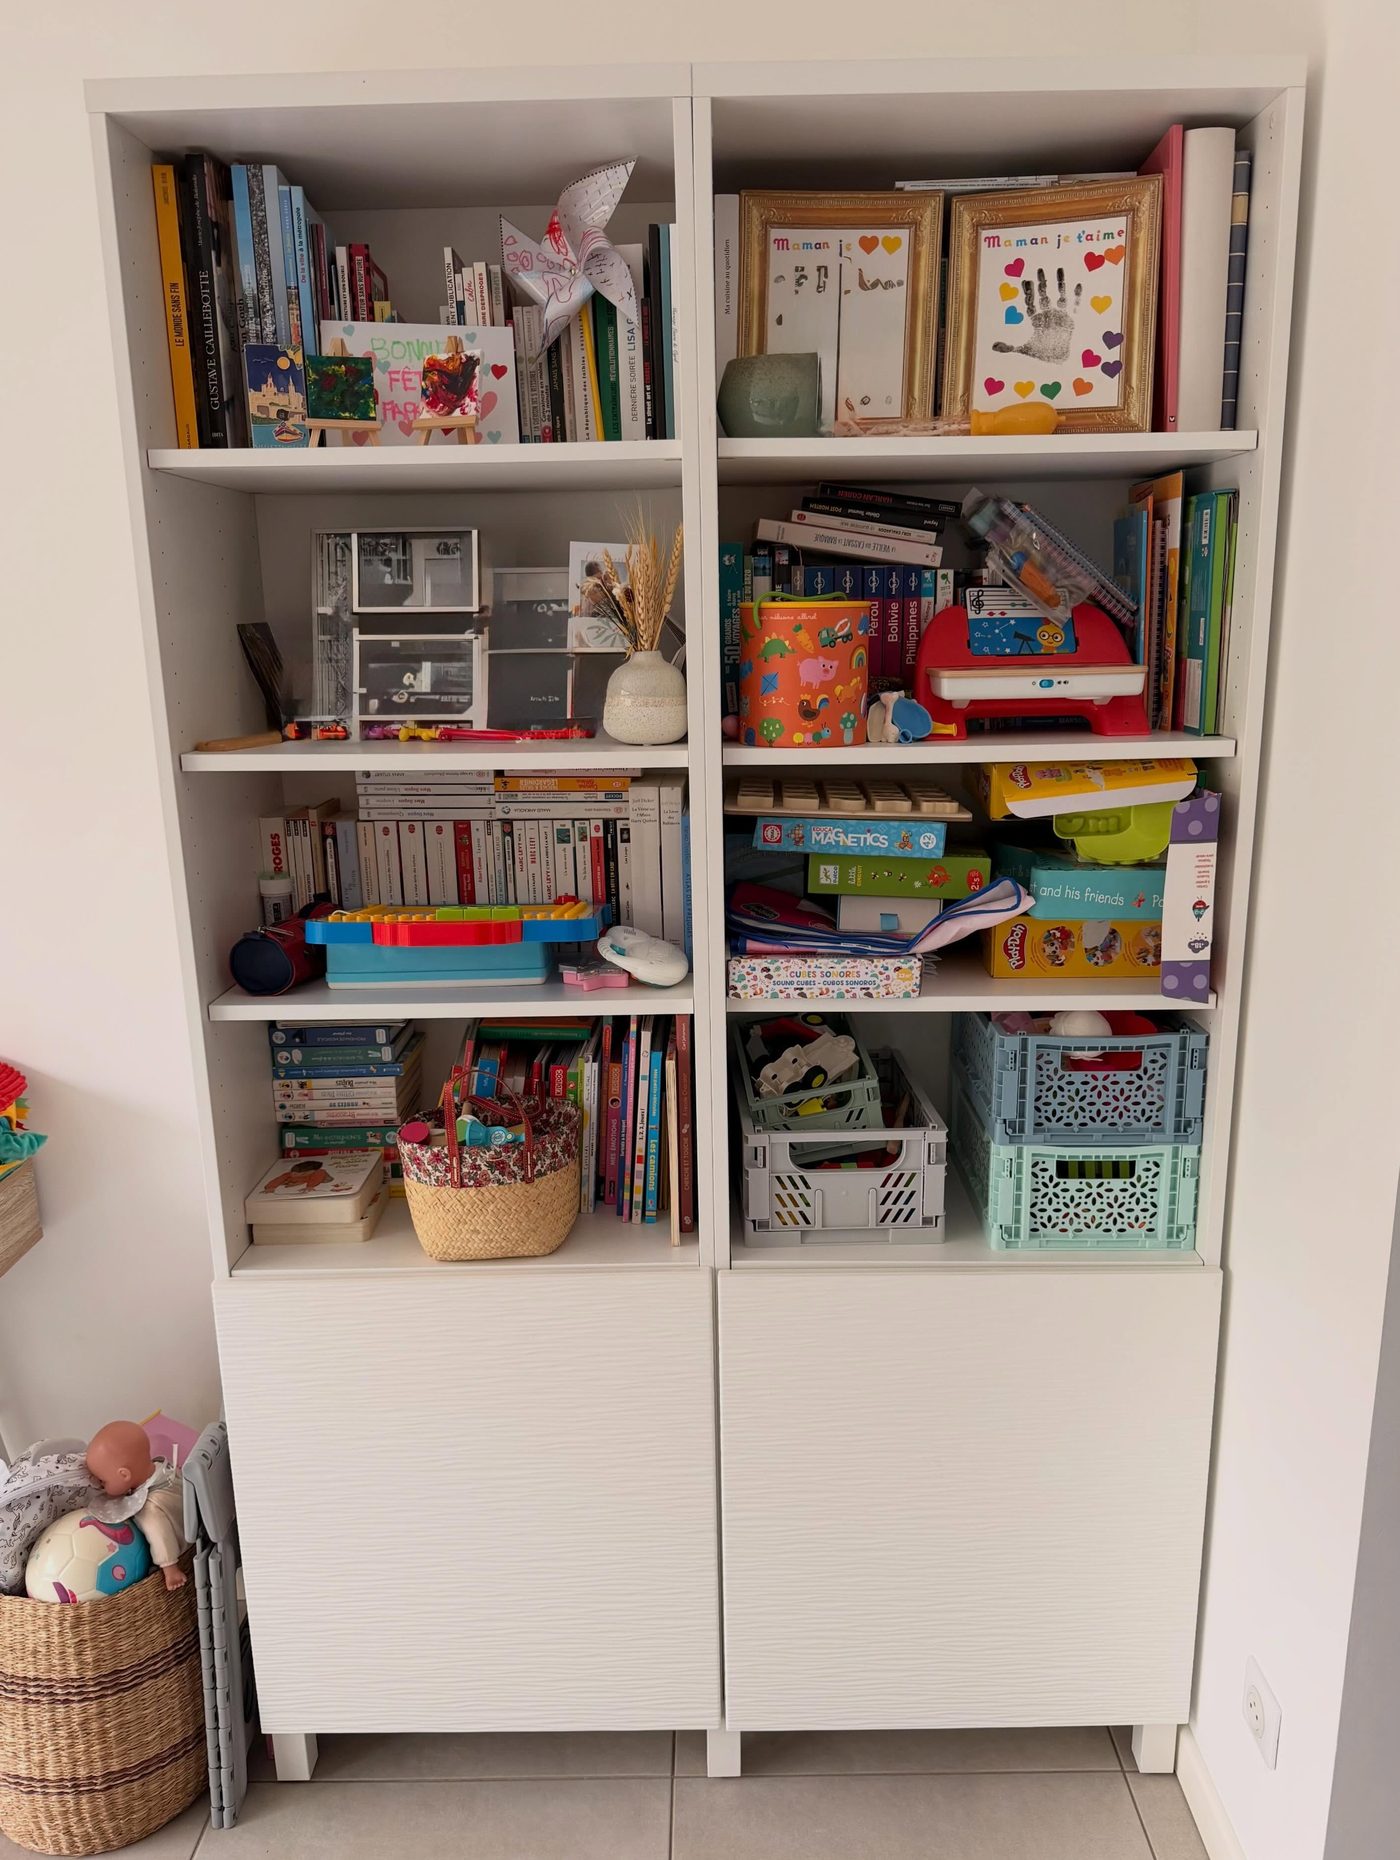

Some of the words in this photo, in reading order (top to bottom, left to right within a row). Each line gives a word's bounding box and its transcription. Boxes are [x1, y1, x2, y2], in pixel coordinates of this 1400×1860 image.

[773, 237, 830, 251] Maman
[839, 239, 852, 258] je
[984, 234, 1048, 249] Maman
[1056, 234, 1071, 249] je
[1076, 229, 1125, 244] t'aime
[170, 282, 180, 294] FIN
[446, 263, 454, 309] PUBLICATION
[171, 296, 181, 312] SANS
[199, 270, 216, 355] CAILLEBOTTE
[237, 299, 246, 328] Gogh
[173, 315, 183, 337] MONDE
[175, 339, 184, 347] LE
[627, 328, 636, 351] LISA
[628, 356, 636, 382] SOIRÉE
[207, 359, 221, 410] GUSTAVE
[628, 384, 638, 421] DERNIÈRE
[837, 490, 862, 500] COBEN
[863, 493, 892, 505] HARLAN
[810, 503, 829, 511] MORTEM
[813, 534, 837, 544] BARAQUE
[873, 542, 890, 552] VIEILLE
[732, 608, 741, 644] VOYAGES
[869, 602, 879, 636] Pérou
[888, 602, 899, 642] Bolivie
[906, 601, 919, 664] Philippines
[724, 646, 741, 664] 50
[811, 828, 888, 848] MAGNETICS
[1039, 886, 1061, 898] and
[1065, 886, 1080, 900] his
[1084, 888, 1125, 907] friends
[789, 970, 817, 979] CUBES
[820, 970, 861, 979] SONORES
[555, 1069, 564, 1096] KIDIDOC
[649, 1155, 657, 1191] camions
